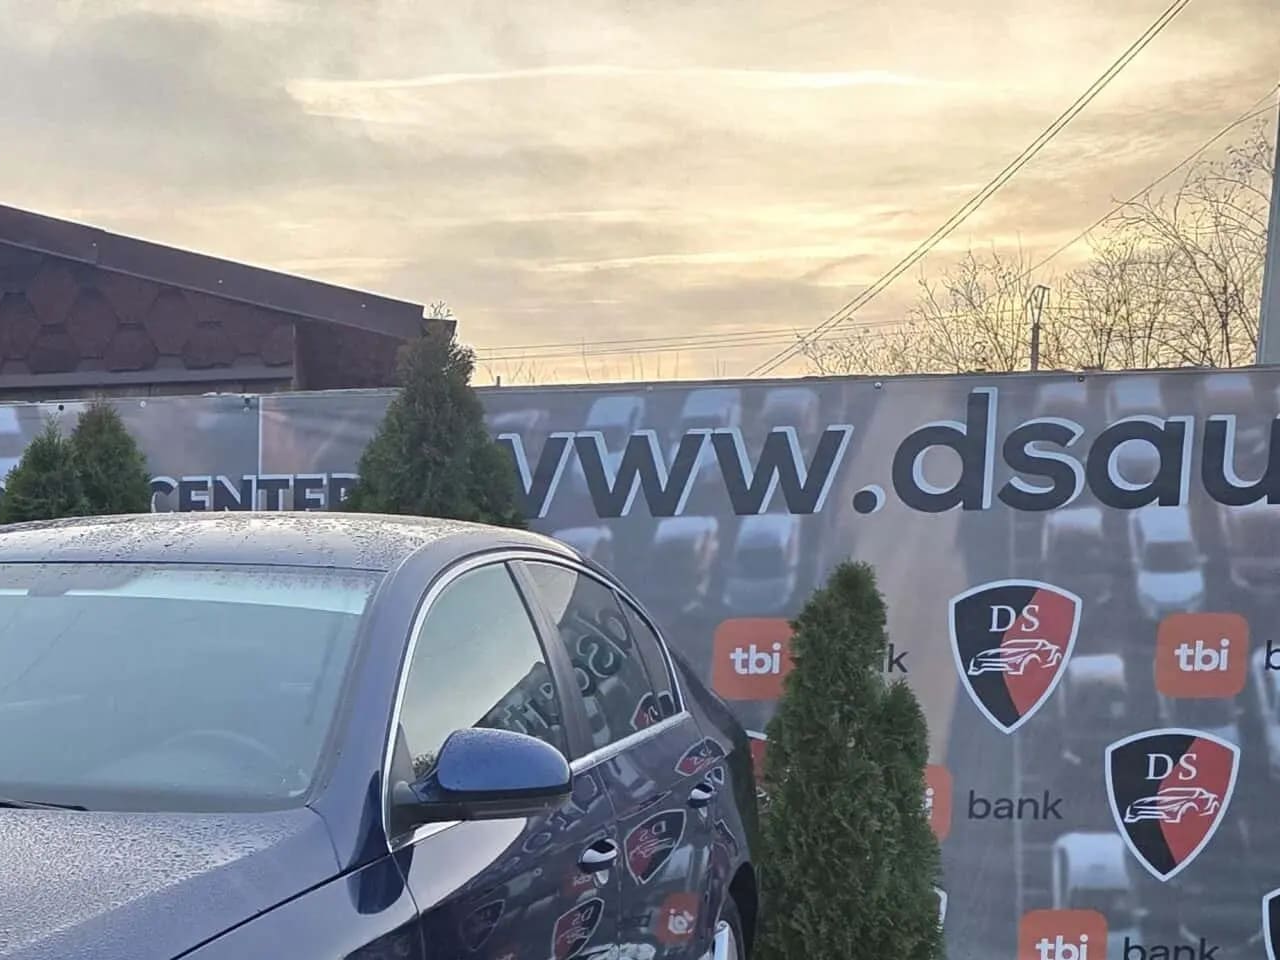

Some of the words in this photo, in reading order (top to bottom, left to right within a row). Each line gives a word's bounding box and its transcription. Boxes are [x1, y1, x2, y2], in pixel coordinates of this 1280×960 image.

[989, 604, 1040, 633] DS
[729, 642, 782, 674] tbi
[1174, 638, 1230, 672] tbi
[1145, 752, 1199, 780] DS
[968, 790, 1063, 820] bank
